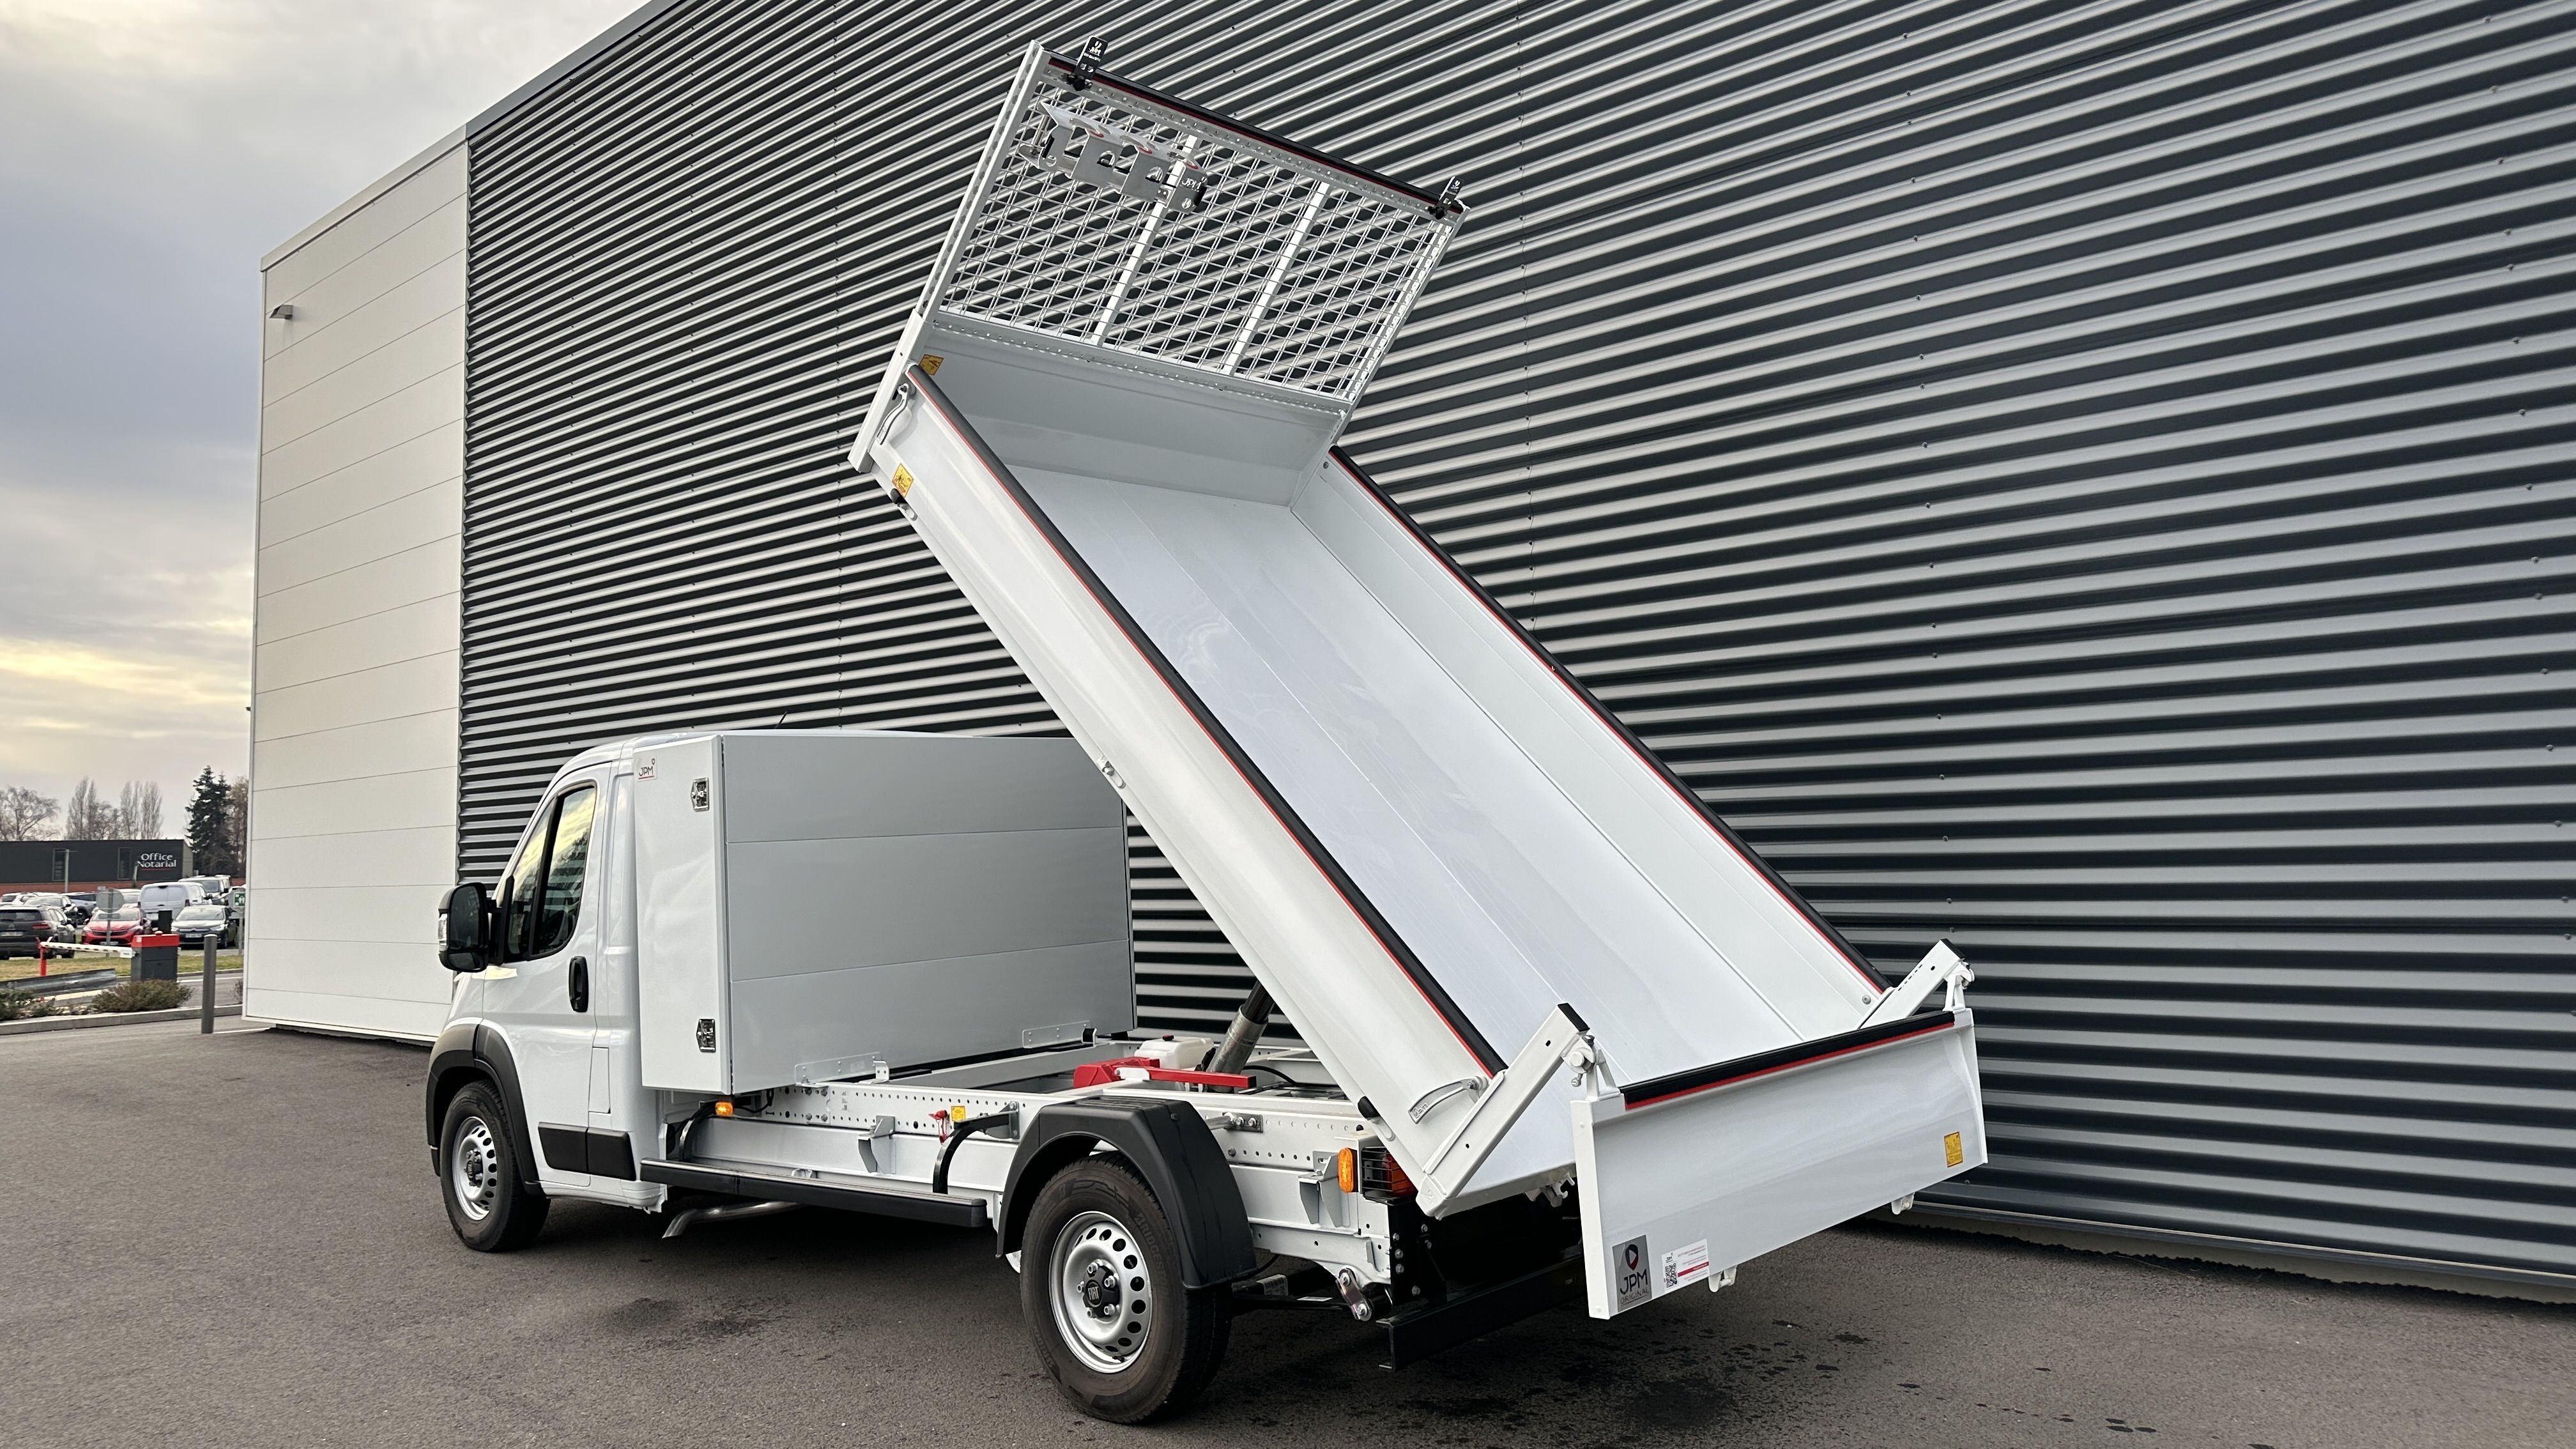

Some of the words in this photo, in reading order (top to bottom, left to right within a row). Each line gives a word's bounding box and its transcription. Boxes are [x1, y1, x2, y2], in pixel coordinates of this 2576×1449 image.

[639, 766, 654, 776] JPM
[1620, 1268, 1648, 1295] JPM
[1088, 1286, 1099, 1301] FIAT
[1620, 1288, 1650, 1304] ORIGINAL
